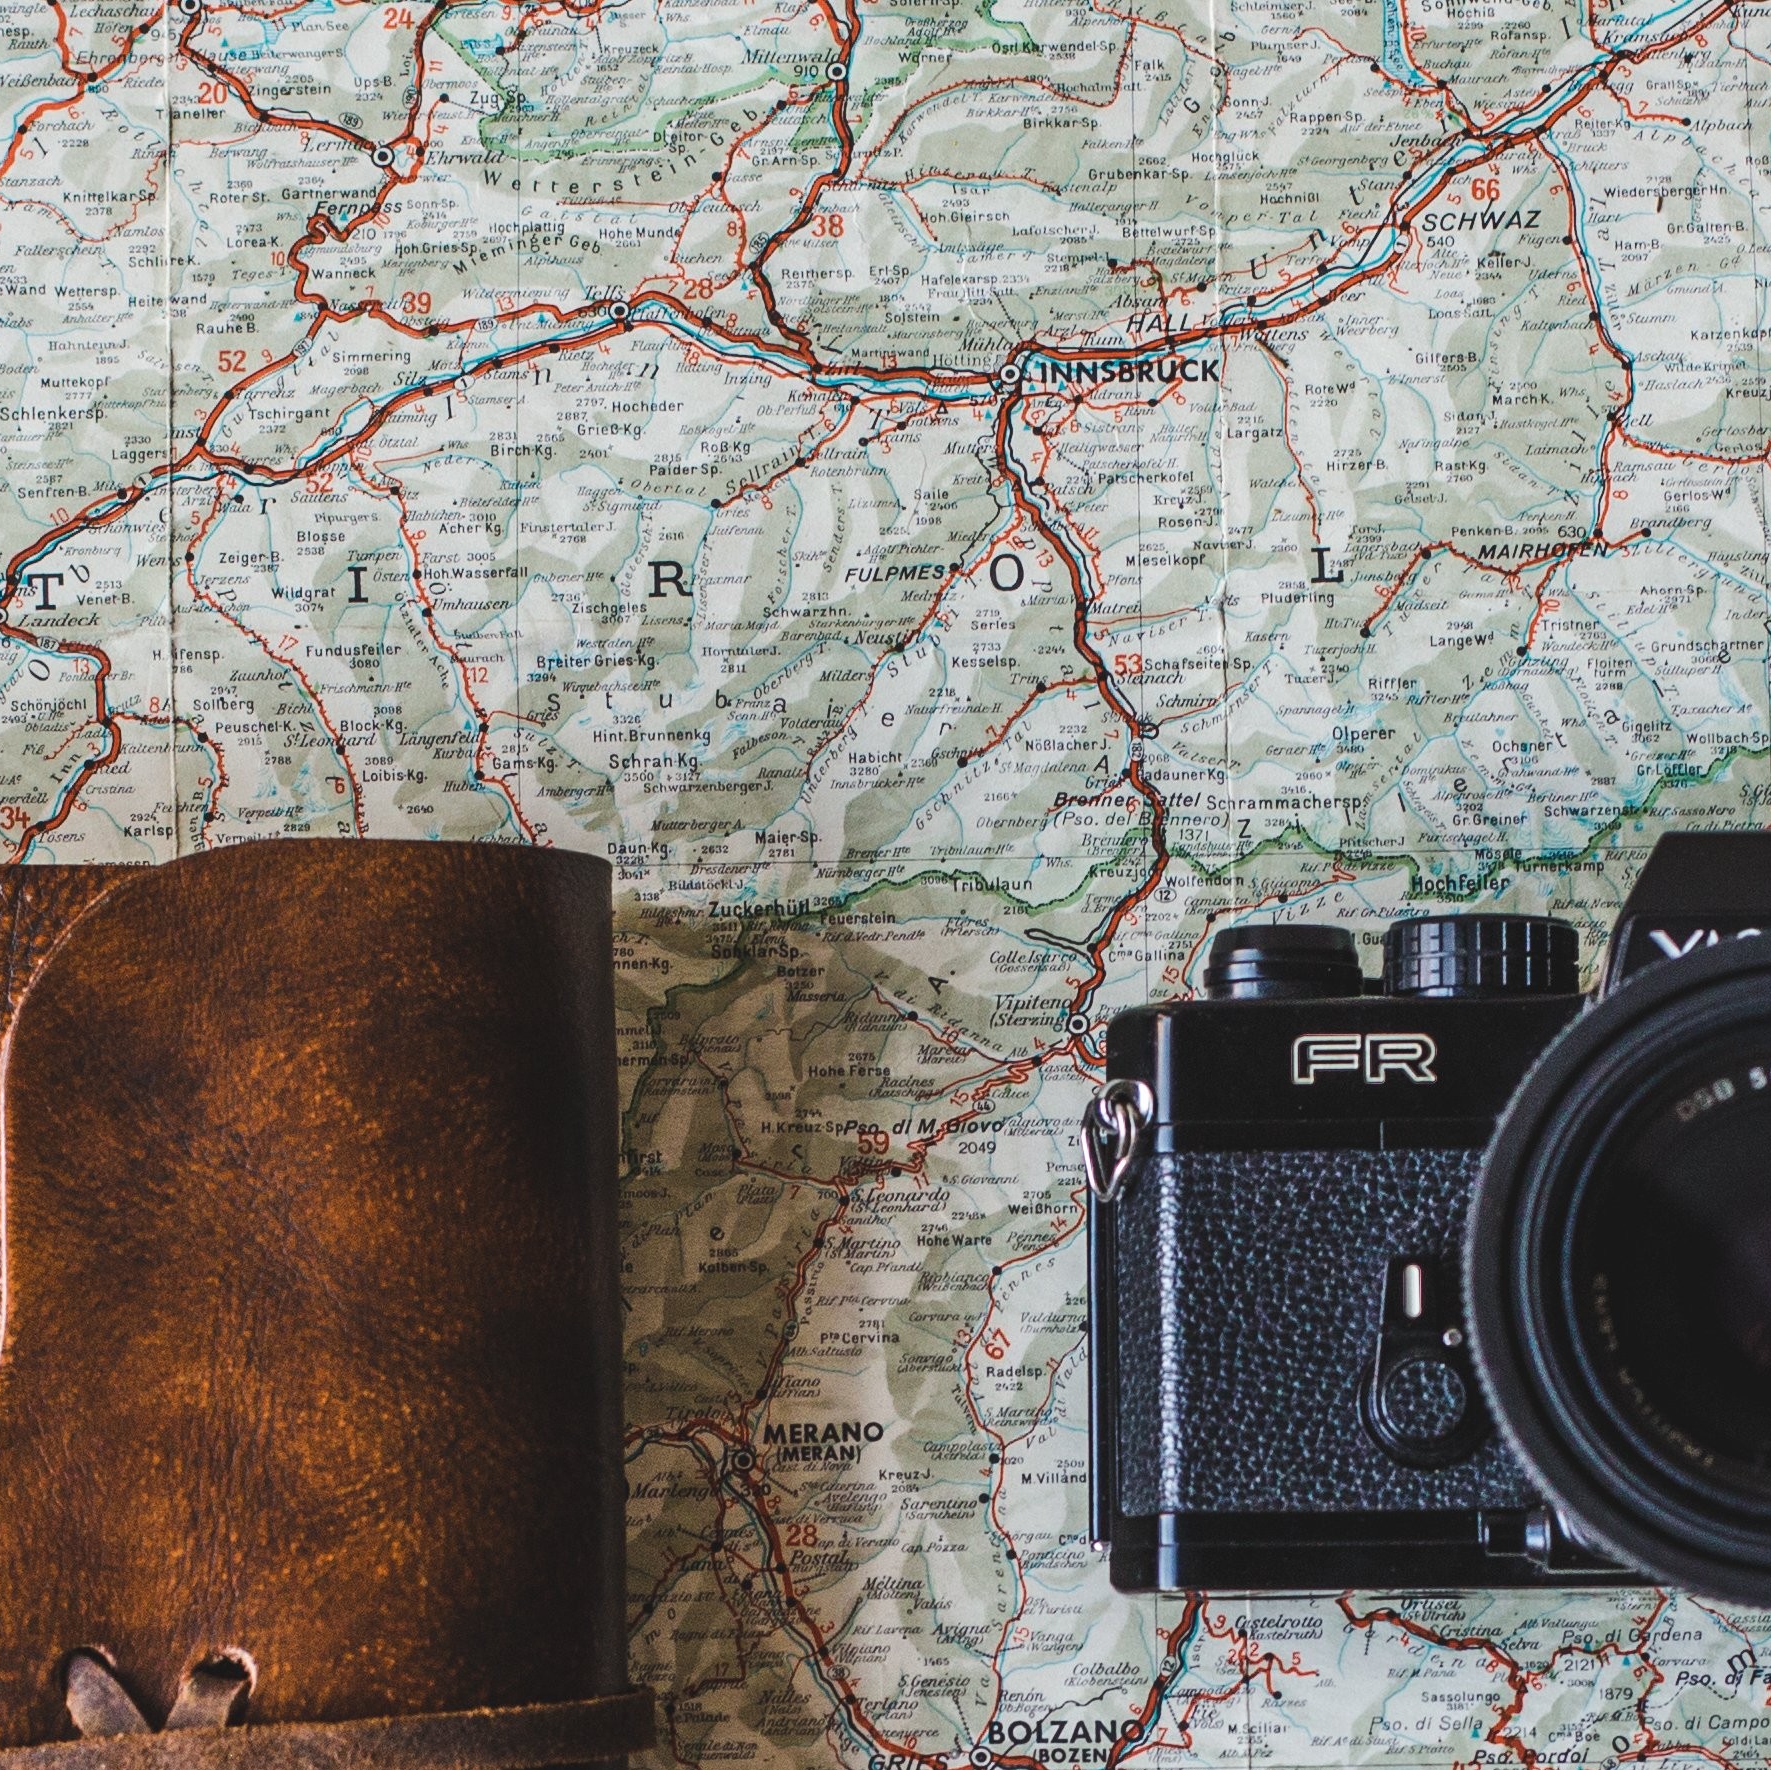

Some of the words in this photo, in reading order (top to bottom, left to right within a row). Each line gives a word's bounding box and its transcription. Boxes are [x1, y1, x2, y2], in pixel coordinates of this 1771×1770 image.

[247, 82, 331, 98] Zingerstein
[1470, 178, 1500, 202] 66
[1421, 208, 1541, 231] SCHWAZ
[1427, 236, 1454, 247] 540
[312, 267, 375, 279] Wanneck
[1125, 312, 1193, 334] HALL
[219, 350, 246, 372] 52
[333, 349, 410, 365] Simmering
[1038, 359, 1219, 385] INNSBRUCK
[0, 404, 109, 422] Schlenkersp.
[248, 405, 330, 423] Tschirgant
[1228, 425, 1283, 442] Largatz
[1099, 469, 1193, 485] Patscherkofel
[1478, 540, 1610, 559] MAIRHOFEN
[1127, 552, 1206, 568] Mieselkopf
[951, 875, 1032, 893] Tribulaun
[1292, 1033, 1437, 1084] FR
[959, 1140, 996, 1154] 2049
[763, 1420, 883, 1446] MERANO
[774, 1442, 861, 1464] (MERAN)
[785, 1522, 819, 1547] 28
[987, 1719, 1144, 1747] BOLZANO
